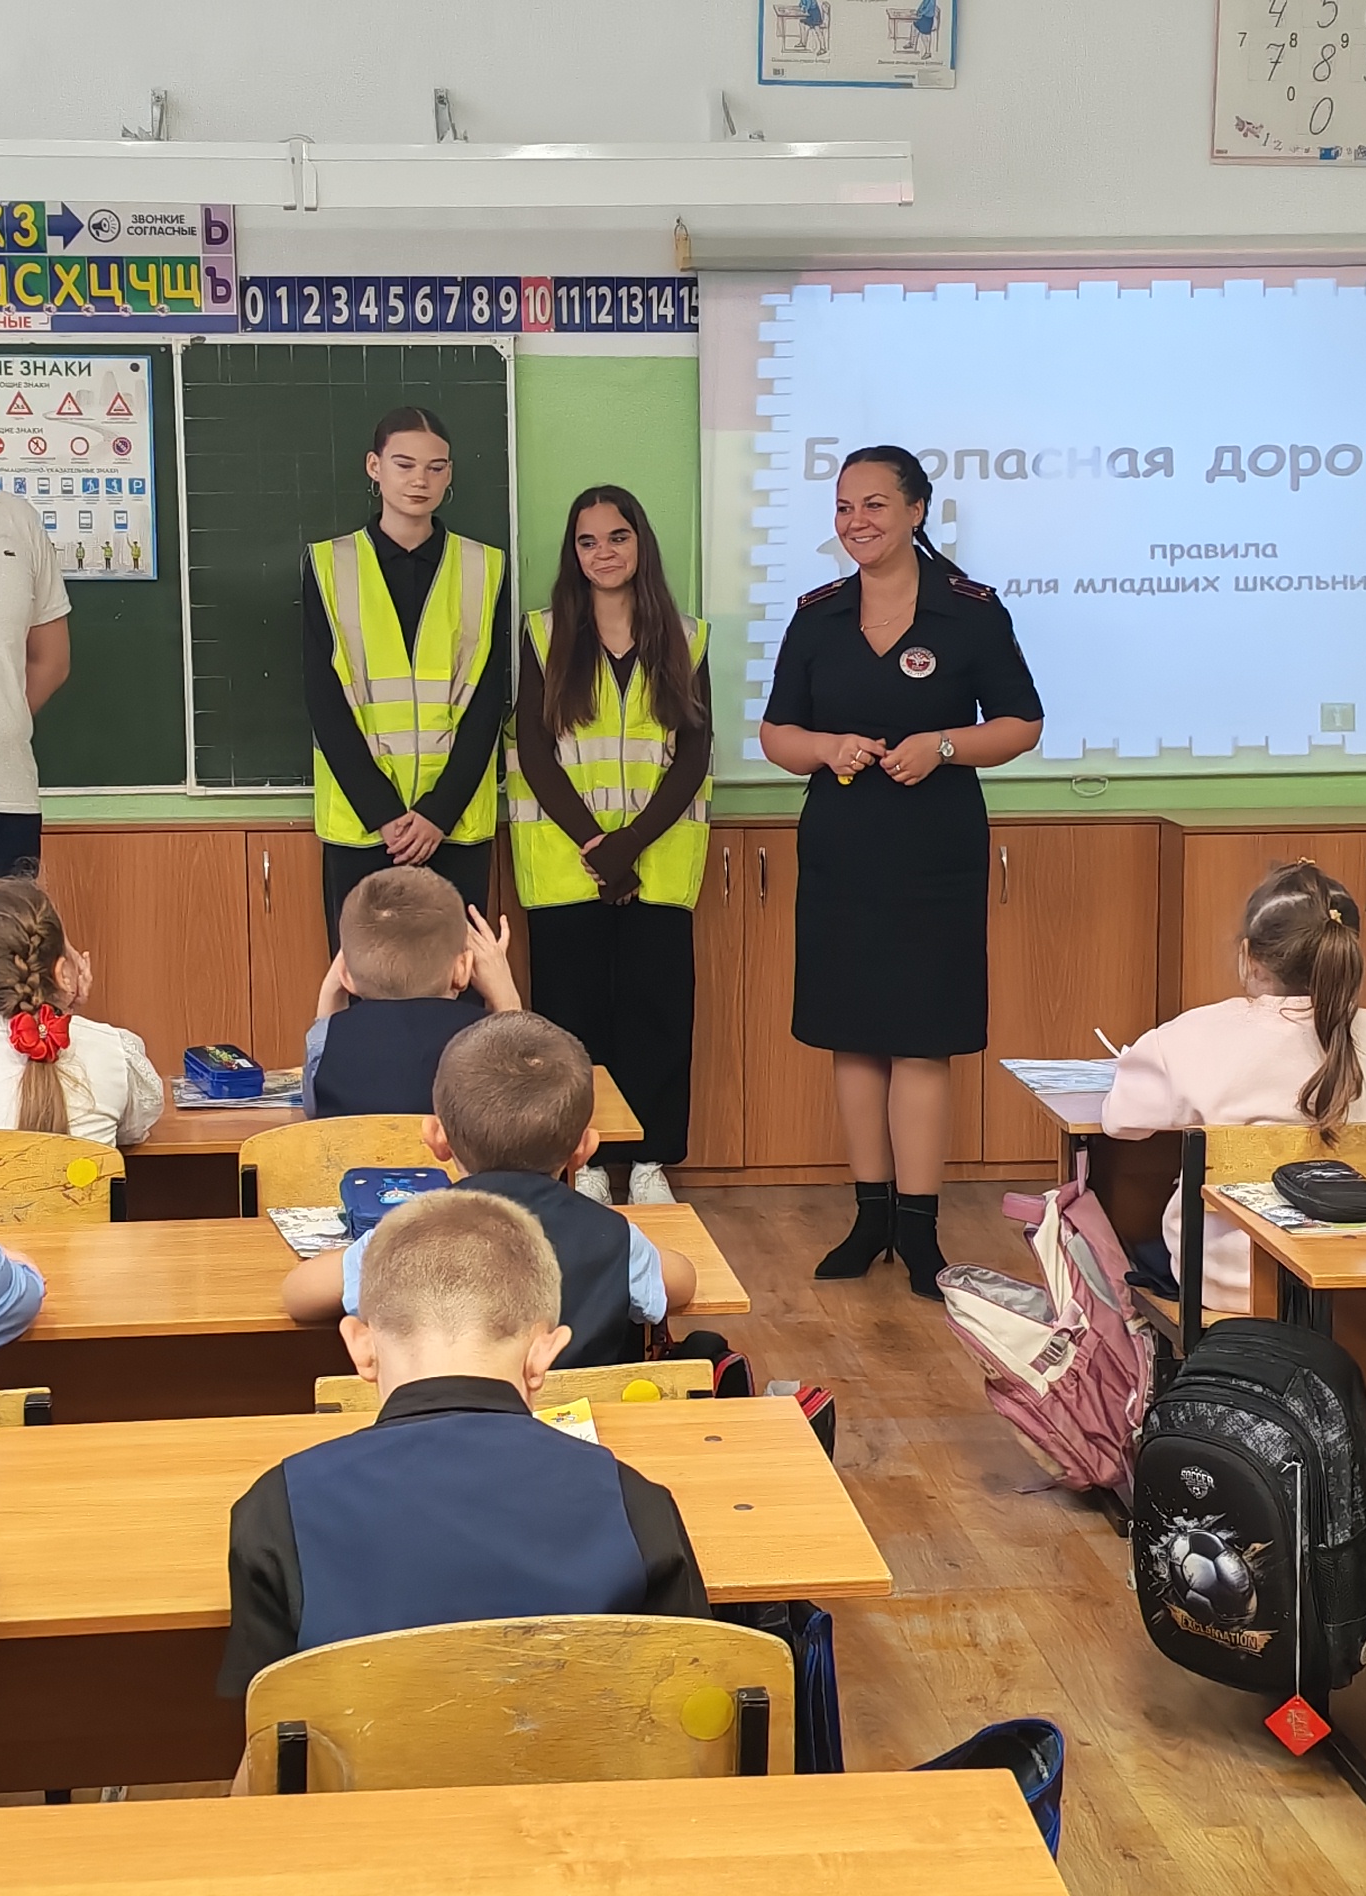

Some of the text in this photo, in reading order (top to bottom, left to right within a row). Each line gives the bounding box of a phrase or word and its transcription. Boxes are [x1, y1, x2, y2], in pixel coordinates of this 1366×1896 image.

[1238, 32, 1350, 48] 7 8 9
[1266, 43, 1285, 81] 7
[1312, 43, 1336, 82] 8
[1286, 85, 1295, 101] 0
[1309, 97, 1334, 135] 0
[12, 204, 39, 247] З
[126, 225, 197, 237] СОГЛАСНЫЕ
[131, 214, 186, 225] ЗВОНКИЕ
[204, 207, 229, 246] Ь
[14, 262, 43, 306] С
[53, 262, 84, 306] Х
[89, 262, 122, 306] Ц
[129, 262, 157, 306] Ч
[162, 262, 201, 308] Щ
[204, 266, 232, 304] Ъ
[246, 286, 264, 324] 0
[275, 286, 288, 324] 1
[303, 286, 322, 324] 2
[332, 286, 350, 324] 3
[359, 286, 379, 324] 4
[388, 286, 405, 324] 5
[415, 286, 434, 324] 6
[443, 286, 462, 324] 7
[472, 286, 490, 324] 8
[500, 286, 518, 324] 9
[524, 286, 551, 324] 10
[557, 286, 581, 324] 11
[586, 286, 613, 324] 12
[617, 286, 644, 324] 13
[651, 286, 675, 324] 14
[20, 361, 92, 377] ЗНАКИ
[23, 381, 50, 389] ЗНАКИ
[16, 427, 43, 435] ЗНАКИ
[803, 437, 1174, 481] Бопасная
[1150, 542, 1278, 566] правила
[1003, 577, 1059, 598] для
[1074, 575, 1220, 597] младших
[1180, 1469, 1215, 1488] SOCCER
